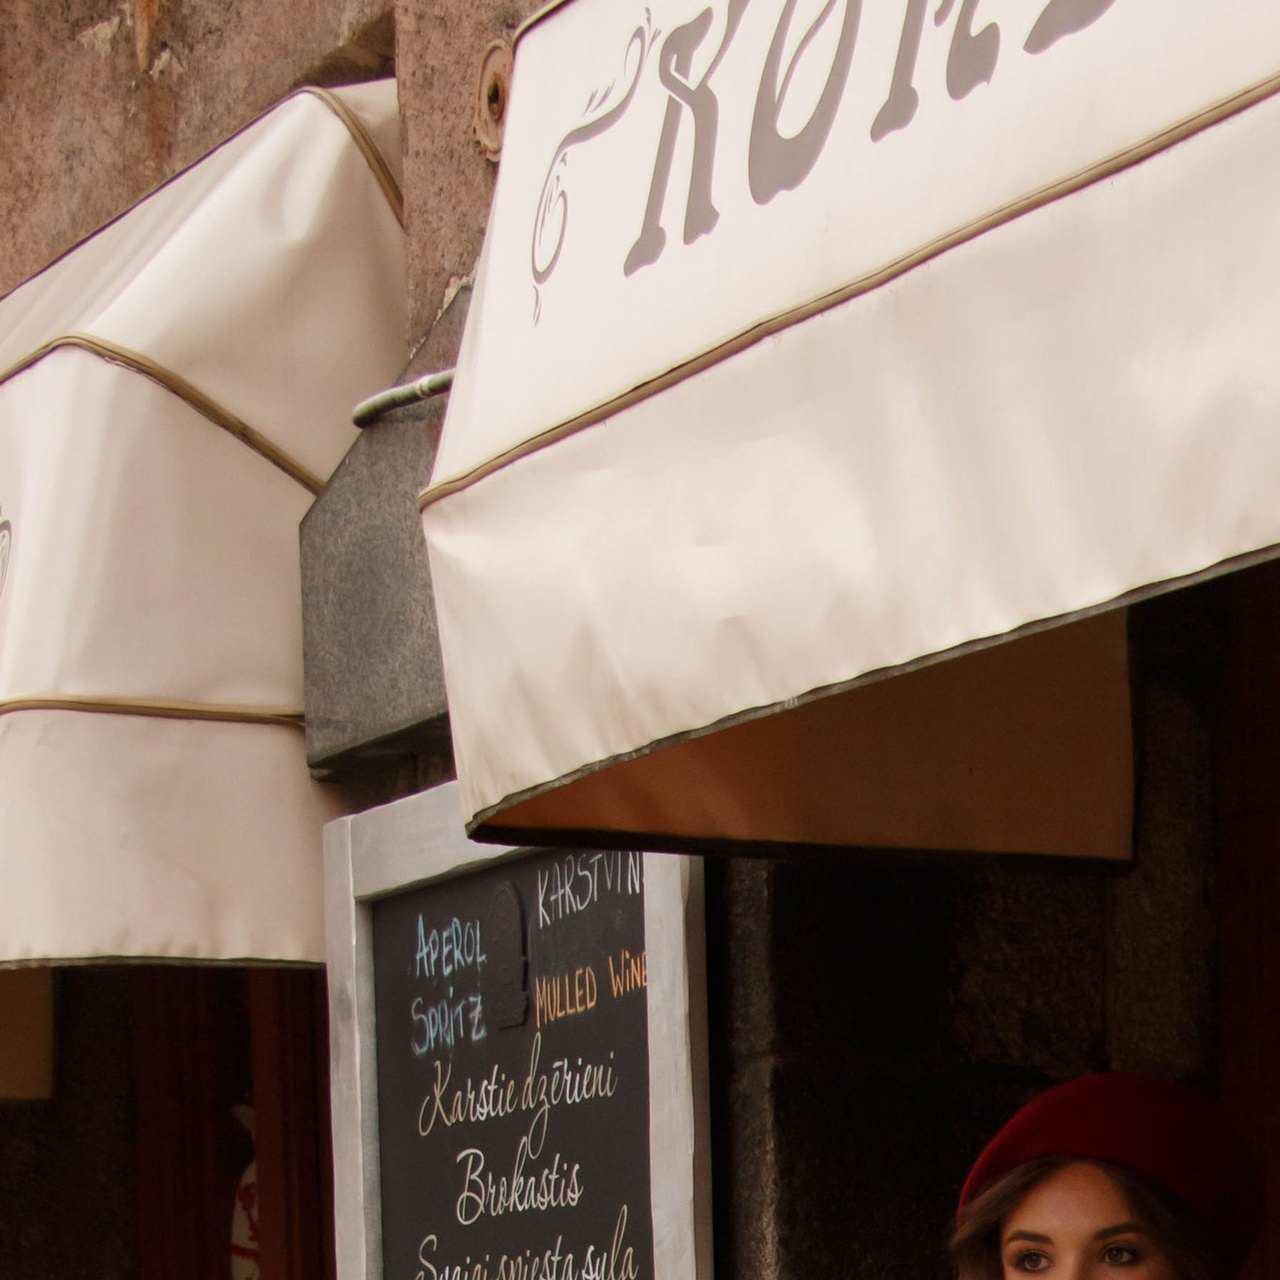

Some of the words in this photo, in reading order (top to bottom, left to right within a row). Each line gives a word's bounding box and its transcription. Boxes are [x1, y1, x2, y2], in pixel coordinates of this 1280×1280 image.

[416, 912, 488, 978] APEROL
[535, 966, 597, 1029] MULLED
[418, 1060, 517, 1137] Karstie
[520, 1031, 619, 1160] dzērieni
[456, 1135, 584, 1226] Brokastis
